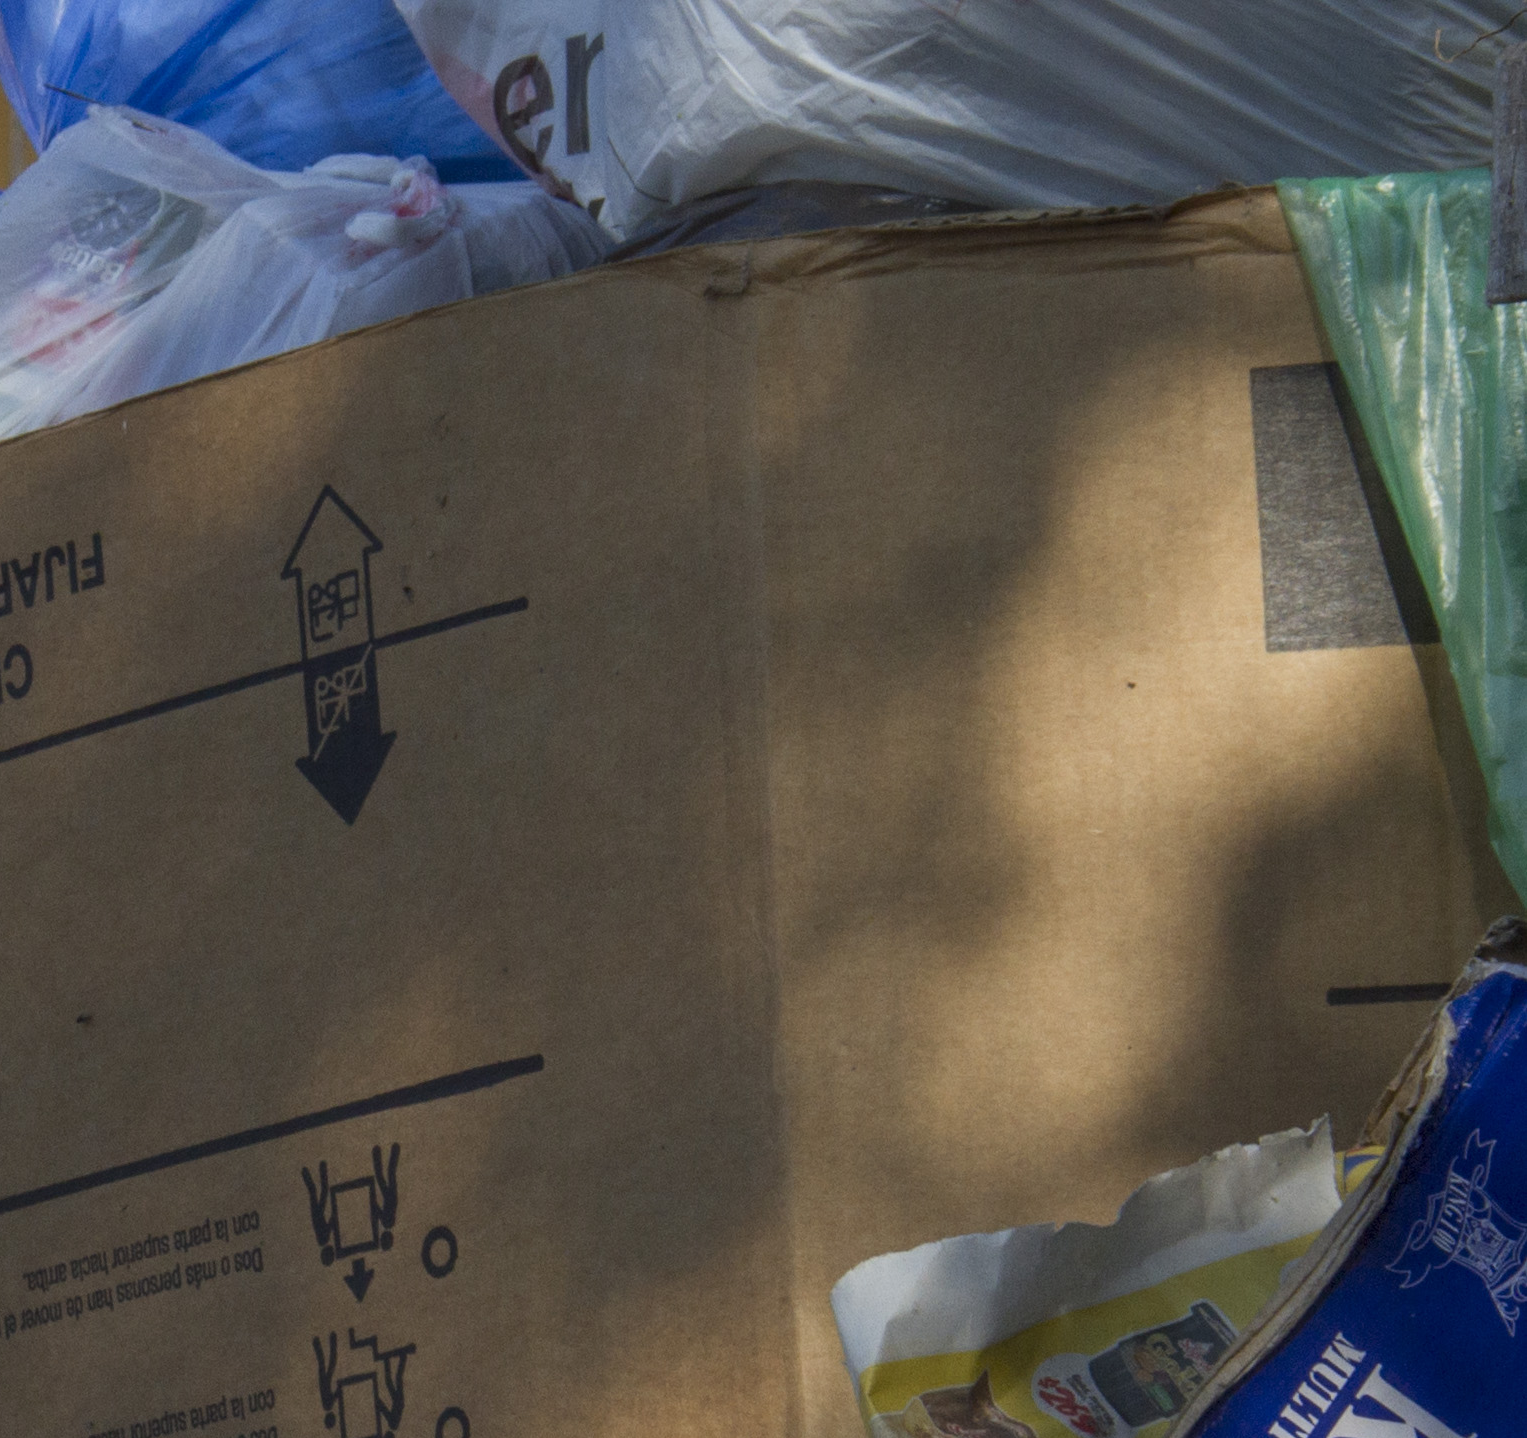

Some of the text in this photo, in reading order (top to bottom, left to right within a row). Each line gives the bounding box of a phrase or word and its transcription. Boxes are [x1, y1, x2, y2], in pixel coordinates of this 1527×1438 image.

[493, 32, 604, 174] er
[173, 1218, 211, 1252] parte
[214, 1219, 229, 1242] la
[232, 1211, 259, 1235] con
[112, 1234, 169, 1268] superior
[234, 1247, 263, 1272] Dos
[70, 1252, 108, 1280] hacia
[185, 1261, 216, 1289] más
[220, 1256, 230, 1276] o
[116, 1264, 181, 1302] personas
[66, 1295, 83, 1320] de
[87, 1288, 113, 1311] han
[4, 1313, 16, 1339] el
[20, 1302, 62, 1330] mover
[190, 1396, 227, 1429] parte
[230, 1397, 245, 1420] la
[248, 1389, 275, 1413] con
